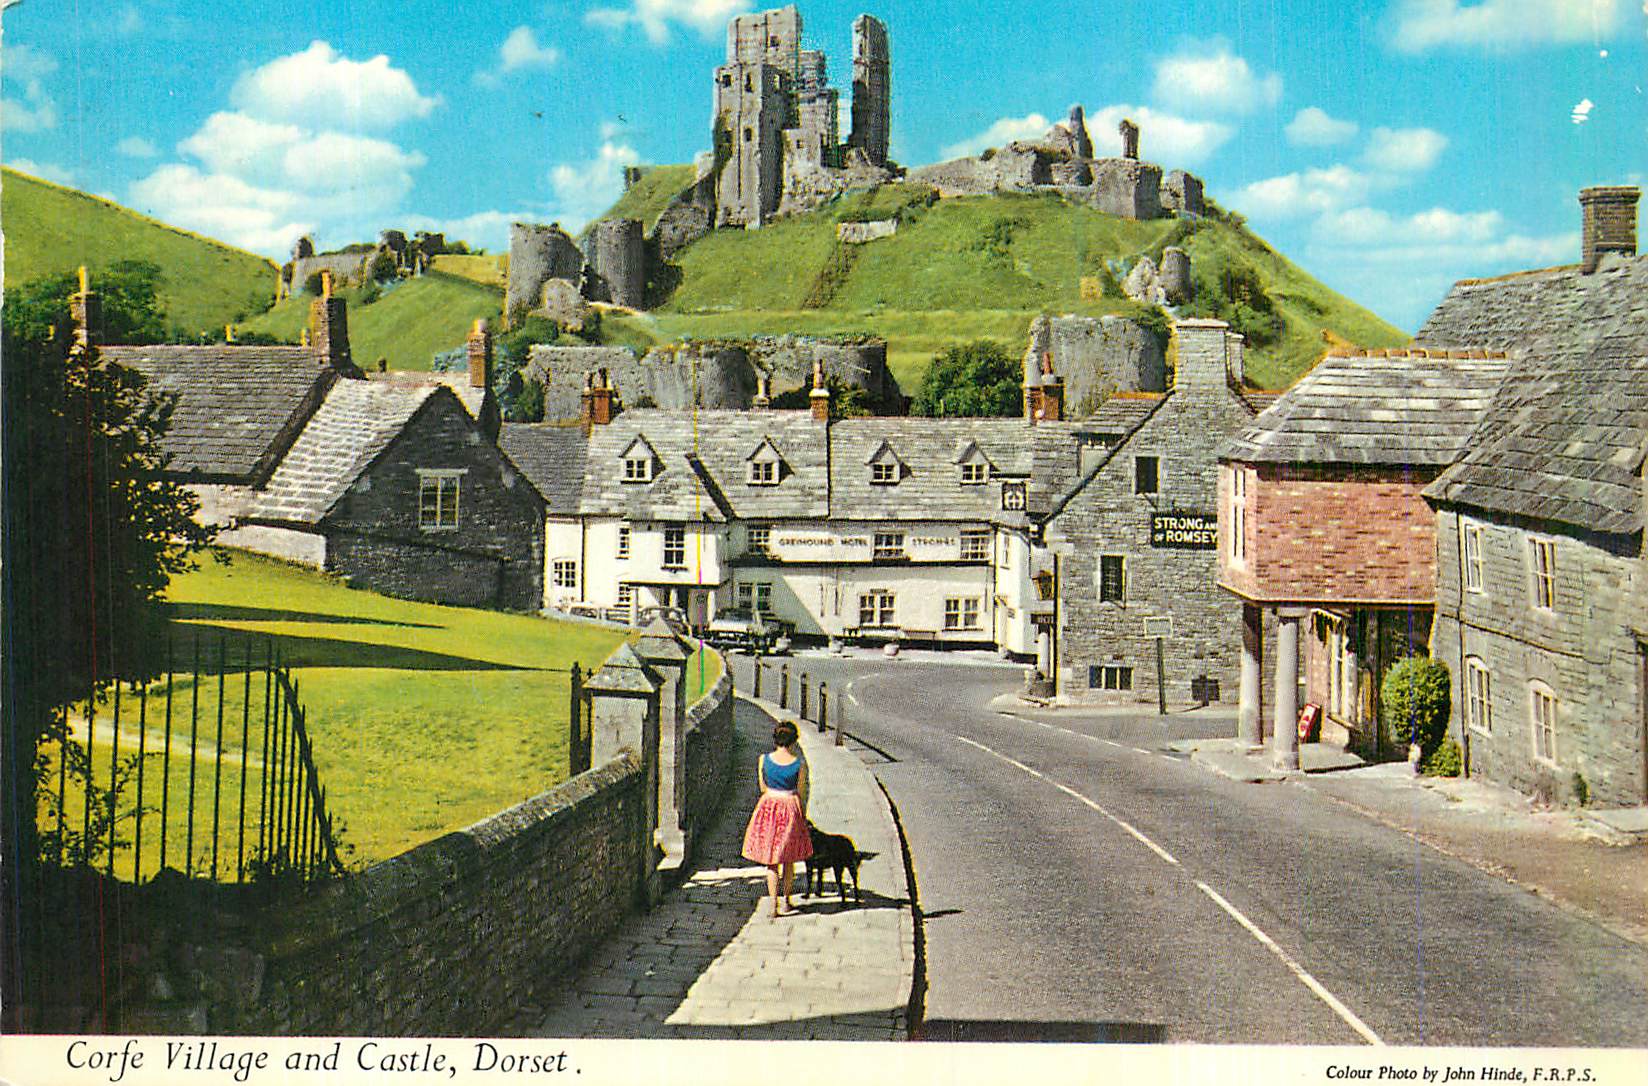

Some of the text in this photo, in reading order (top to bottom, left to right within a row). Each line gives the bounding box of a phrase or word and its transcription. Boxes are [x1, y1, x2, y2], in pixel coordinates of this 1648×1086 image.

[1154, 517, 1203, 530] STRONG
[1154, 530, 1218, 543] OF ROMSEY
